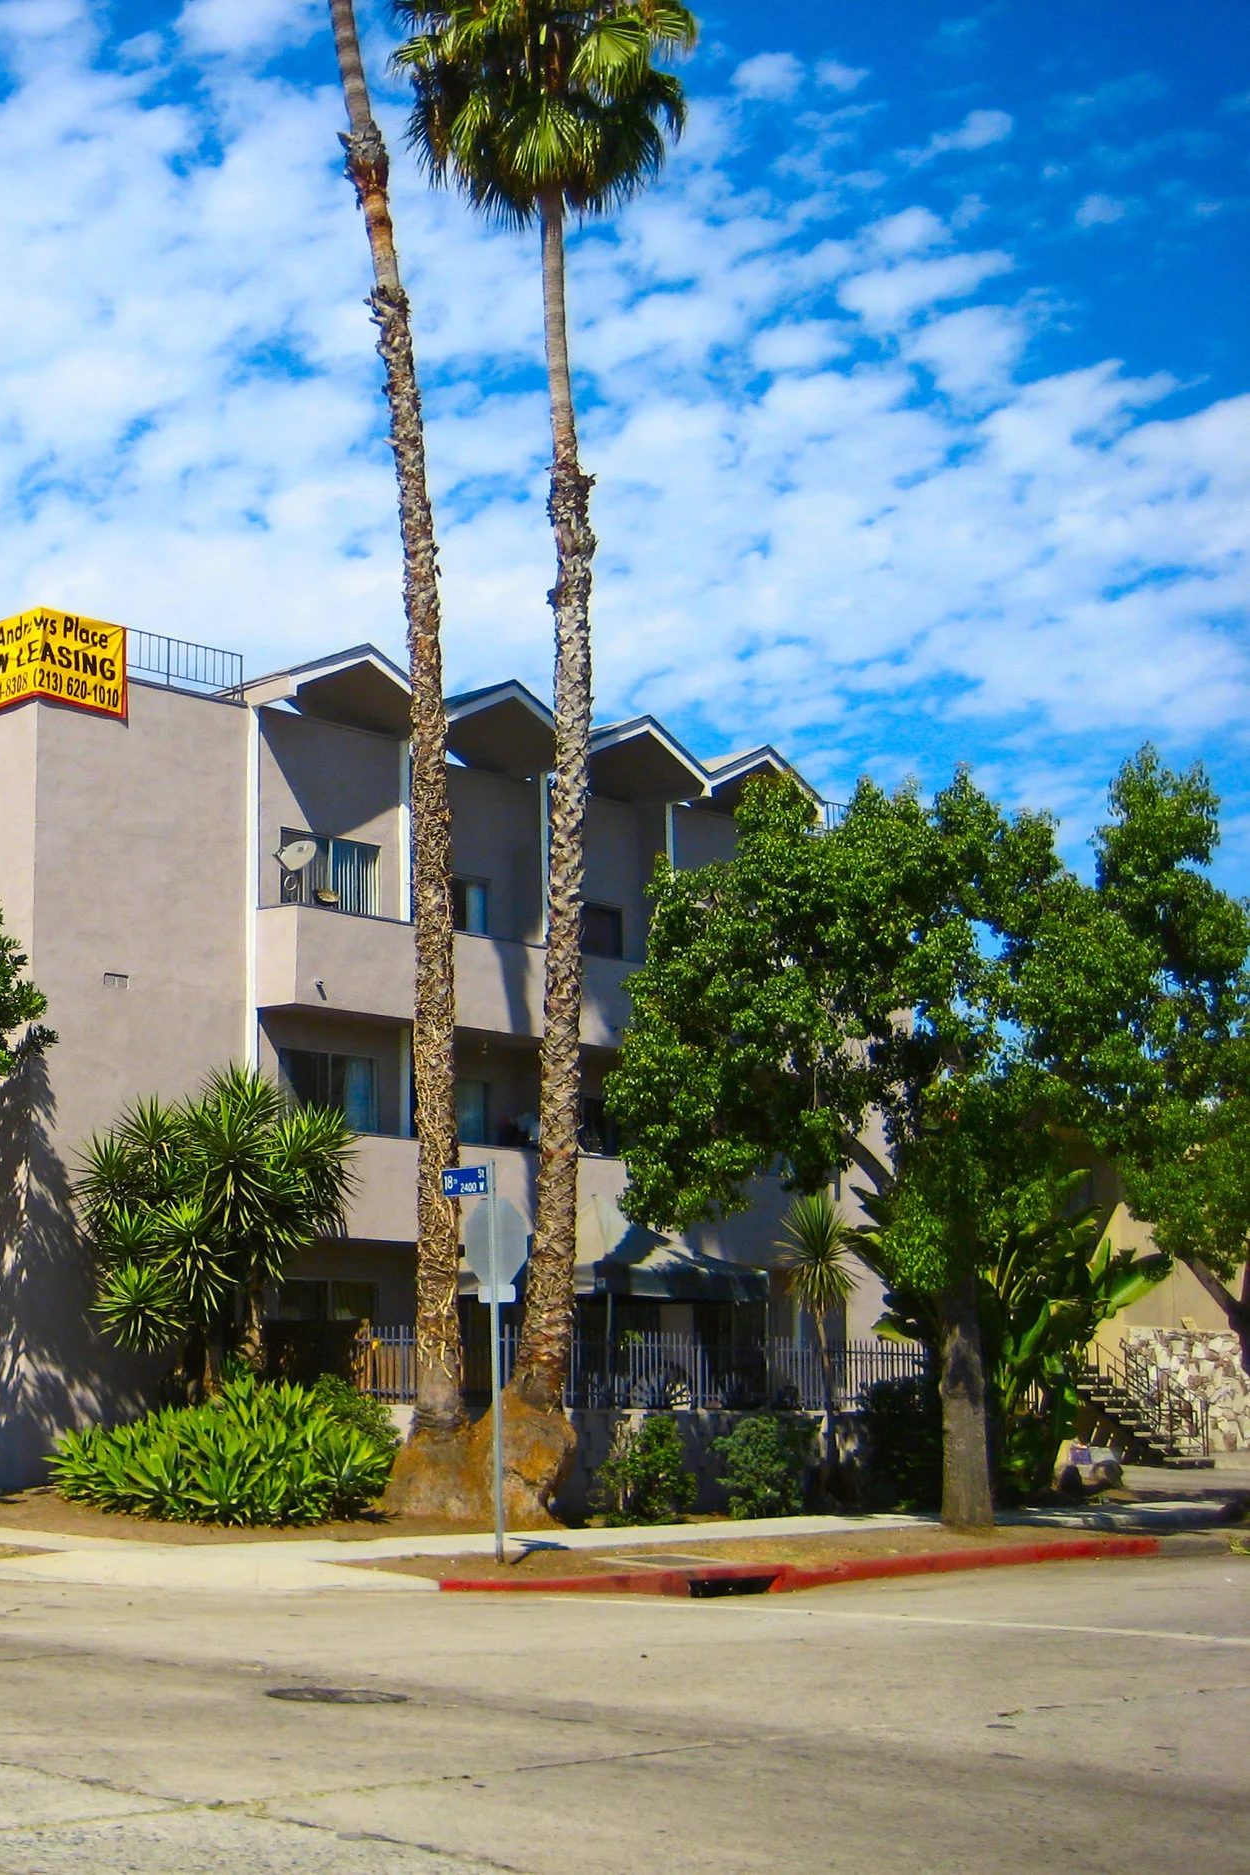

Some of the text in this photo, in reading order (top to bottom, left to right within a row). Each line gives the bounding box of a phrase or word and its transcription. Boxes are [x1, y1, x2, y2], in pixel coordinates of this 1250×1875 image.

[63, 616, 109, 649] Place
[17, 640, 116, 681] LEASING
[33, 668, 63, 693] (213)
[66, 677, 119, 708] 620-1010
[460, 1181, 485, 1193] 2400 W
[477, 1168, 485, 1179] St
